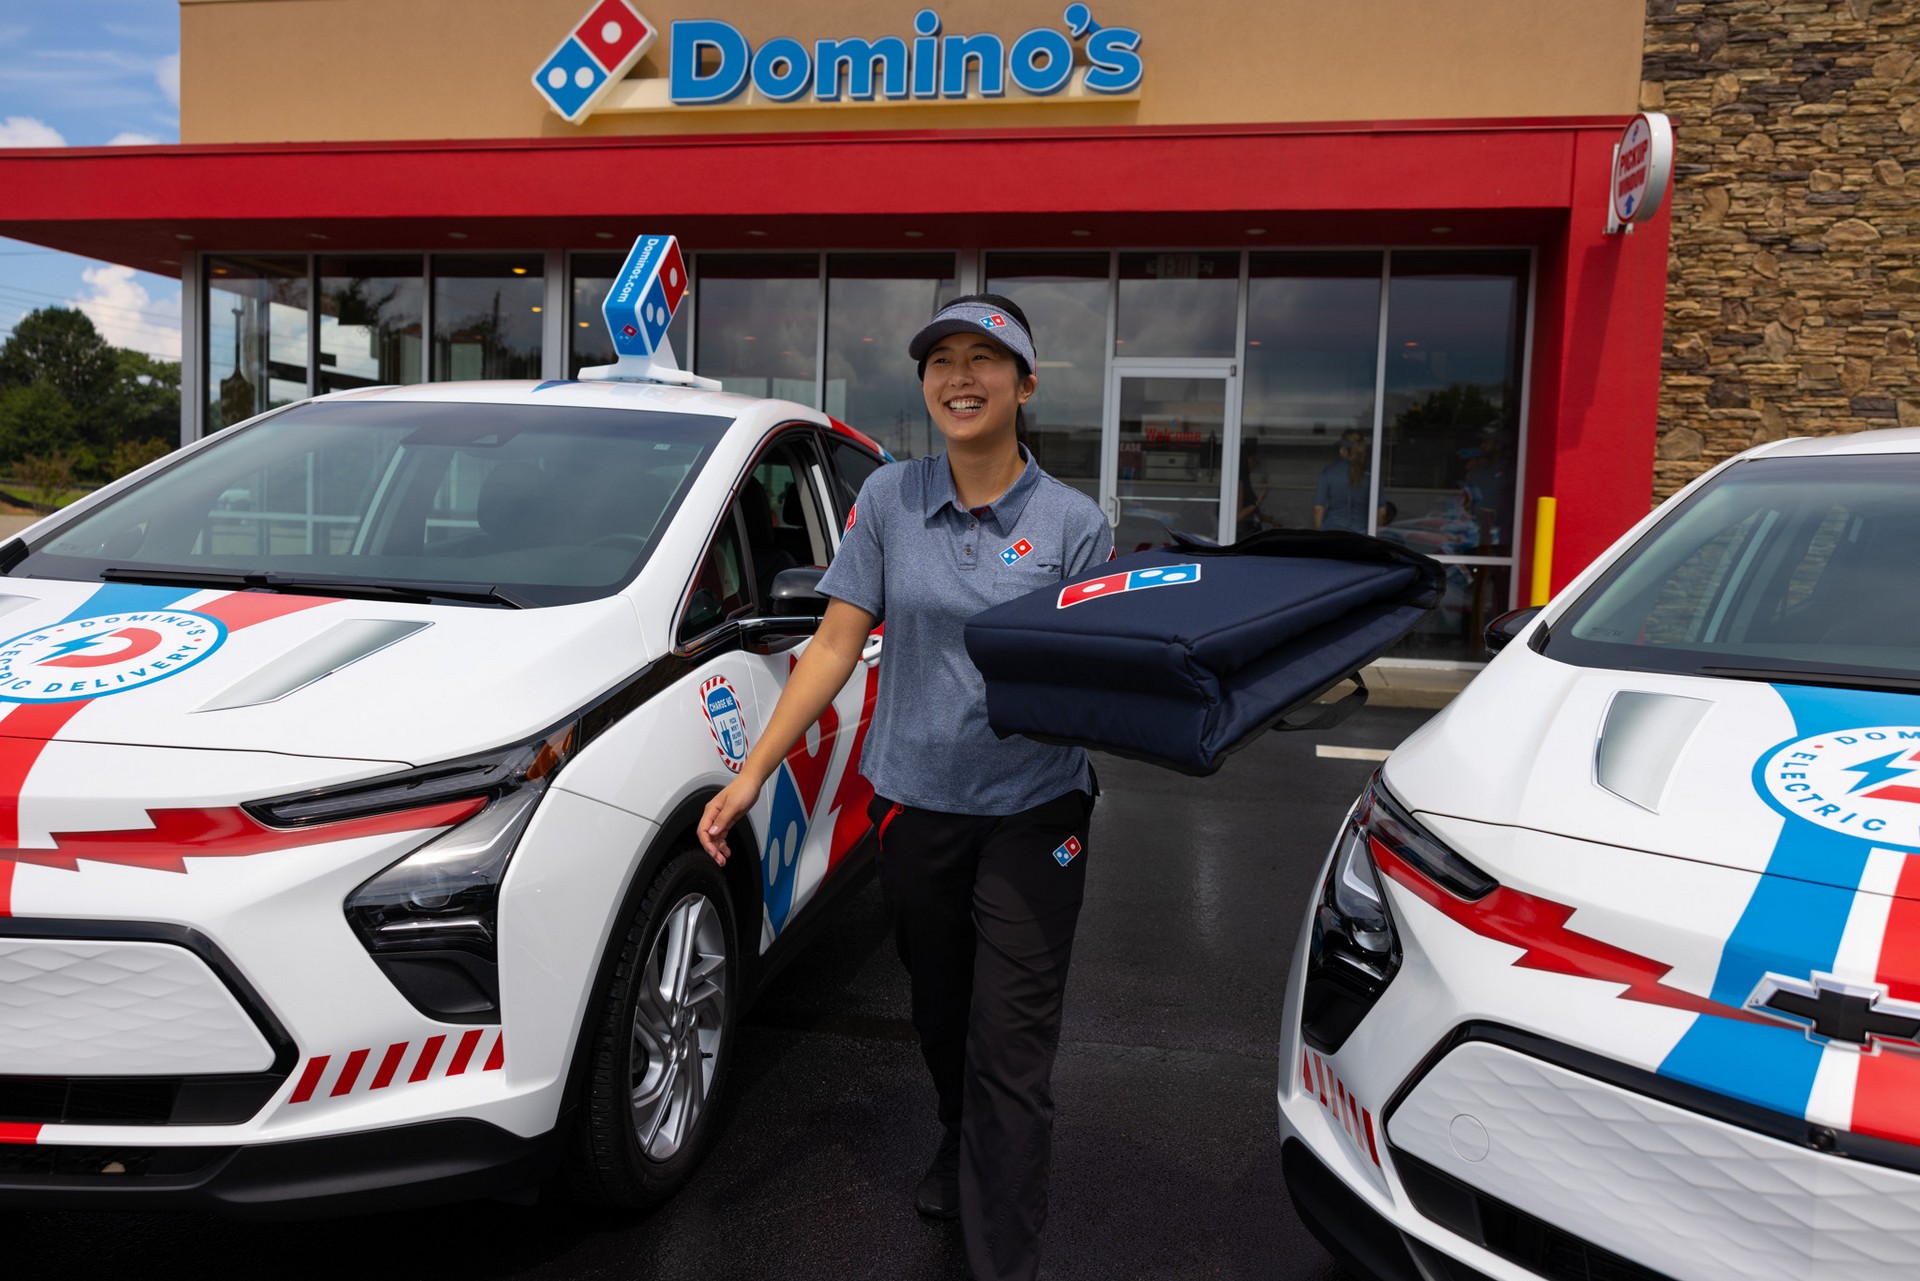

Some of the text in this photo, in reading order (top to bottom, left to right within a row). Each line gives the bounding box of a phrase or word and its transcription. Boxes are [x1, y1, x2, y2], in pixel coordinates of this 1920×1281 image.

[669, 2, 1144, 103] Domino's
[617, 238, 660, 302] Dominos.com
[1145, 427, 1201, 442] Welcome
[80, 614, 207, 637] DOMINO'S
[43, 644, 199, 693] DELIVERY
[1780, 752, 1887, 831] ELECTRIC
